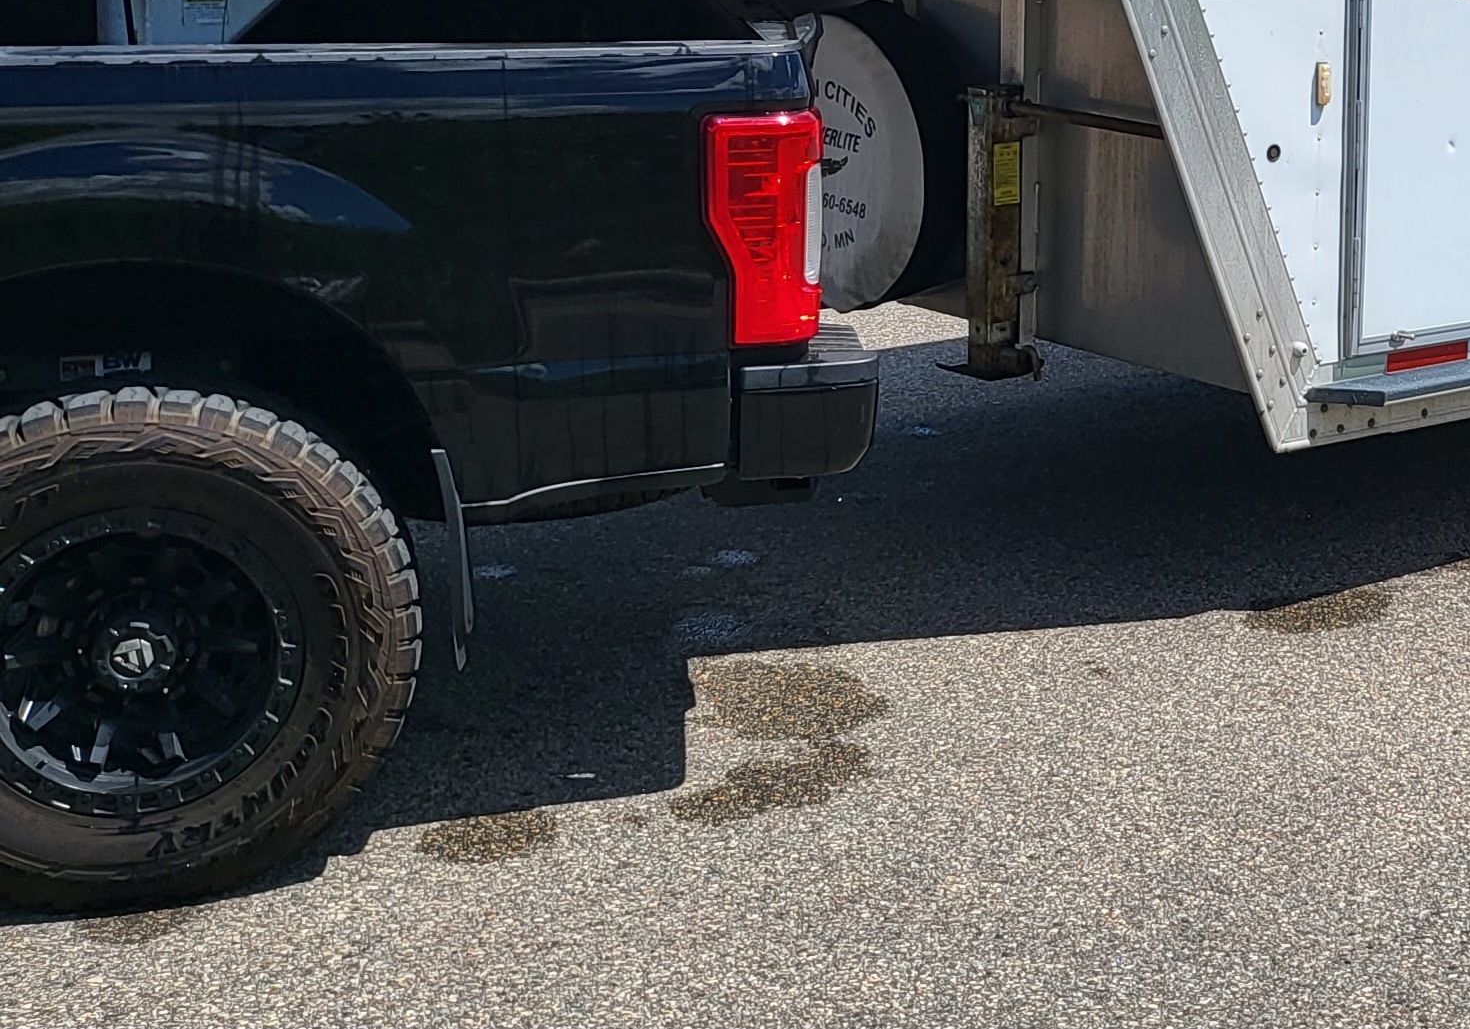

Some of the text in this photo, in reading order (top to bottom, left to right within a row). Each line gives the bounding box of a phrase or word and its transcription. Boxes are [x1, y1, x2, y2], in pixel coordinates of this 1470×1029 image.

[825, 80, 877, 138] CITIES
[822, 126, 861, 153] ERLITE
[822, 192, 867, 219] 60-6548
[834, 228, 855, 249] MN
